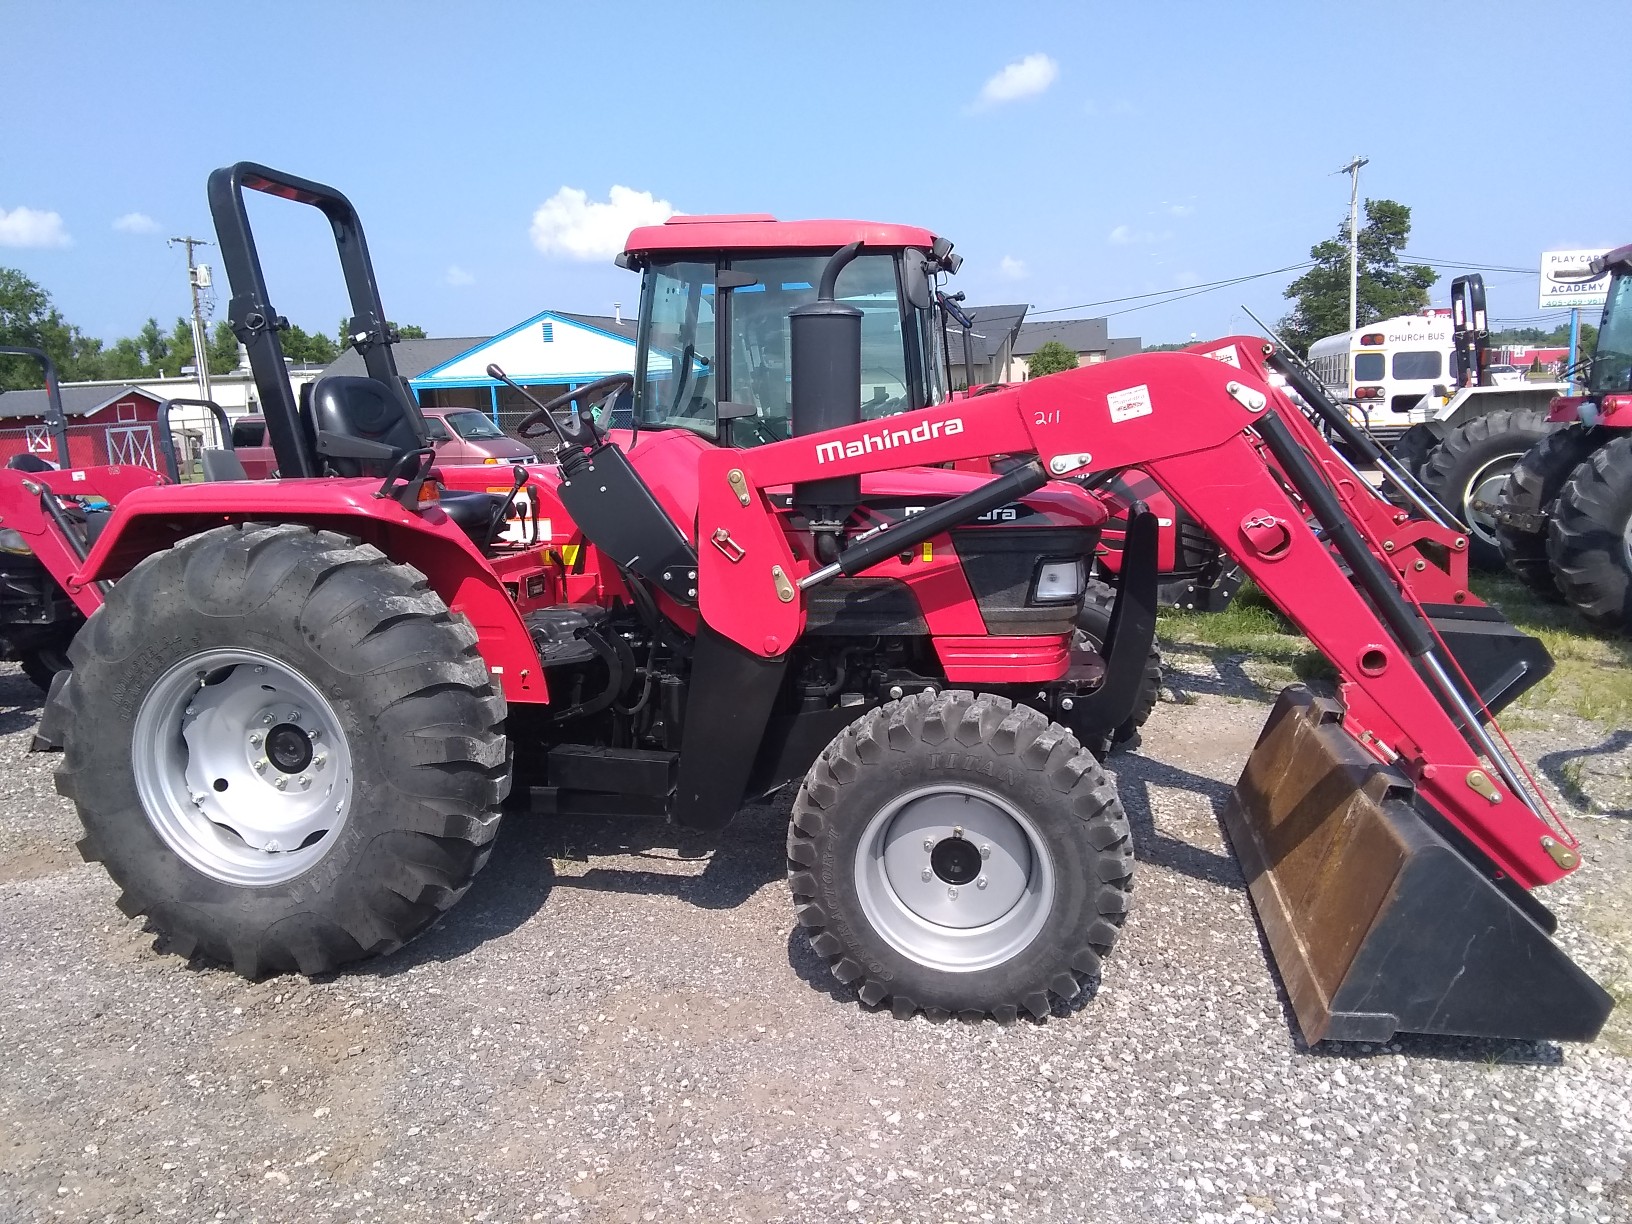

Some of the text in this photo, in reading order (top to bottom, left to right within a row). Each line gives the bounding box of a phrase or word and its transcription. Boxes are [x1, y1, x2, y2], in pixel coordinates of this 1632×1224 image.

[1551, 254, 1604, 263] PLAY CAR
[1550, 283, 1604, 294] ACADEMY
[1388, 332, 1445, 342] CHURCH BUS
[1034, 410, 1061, 425] 211
[815, 417, 964, 465] Mahindra
[927, 752, 1024, 787] TITAN
